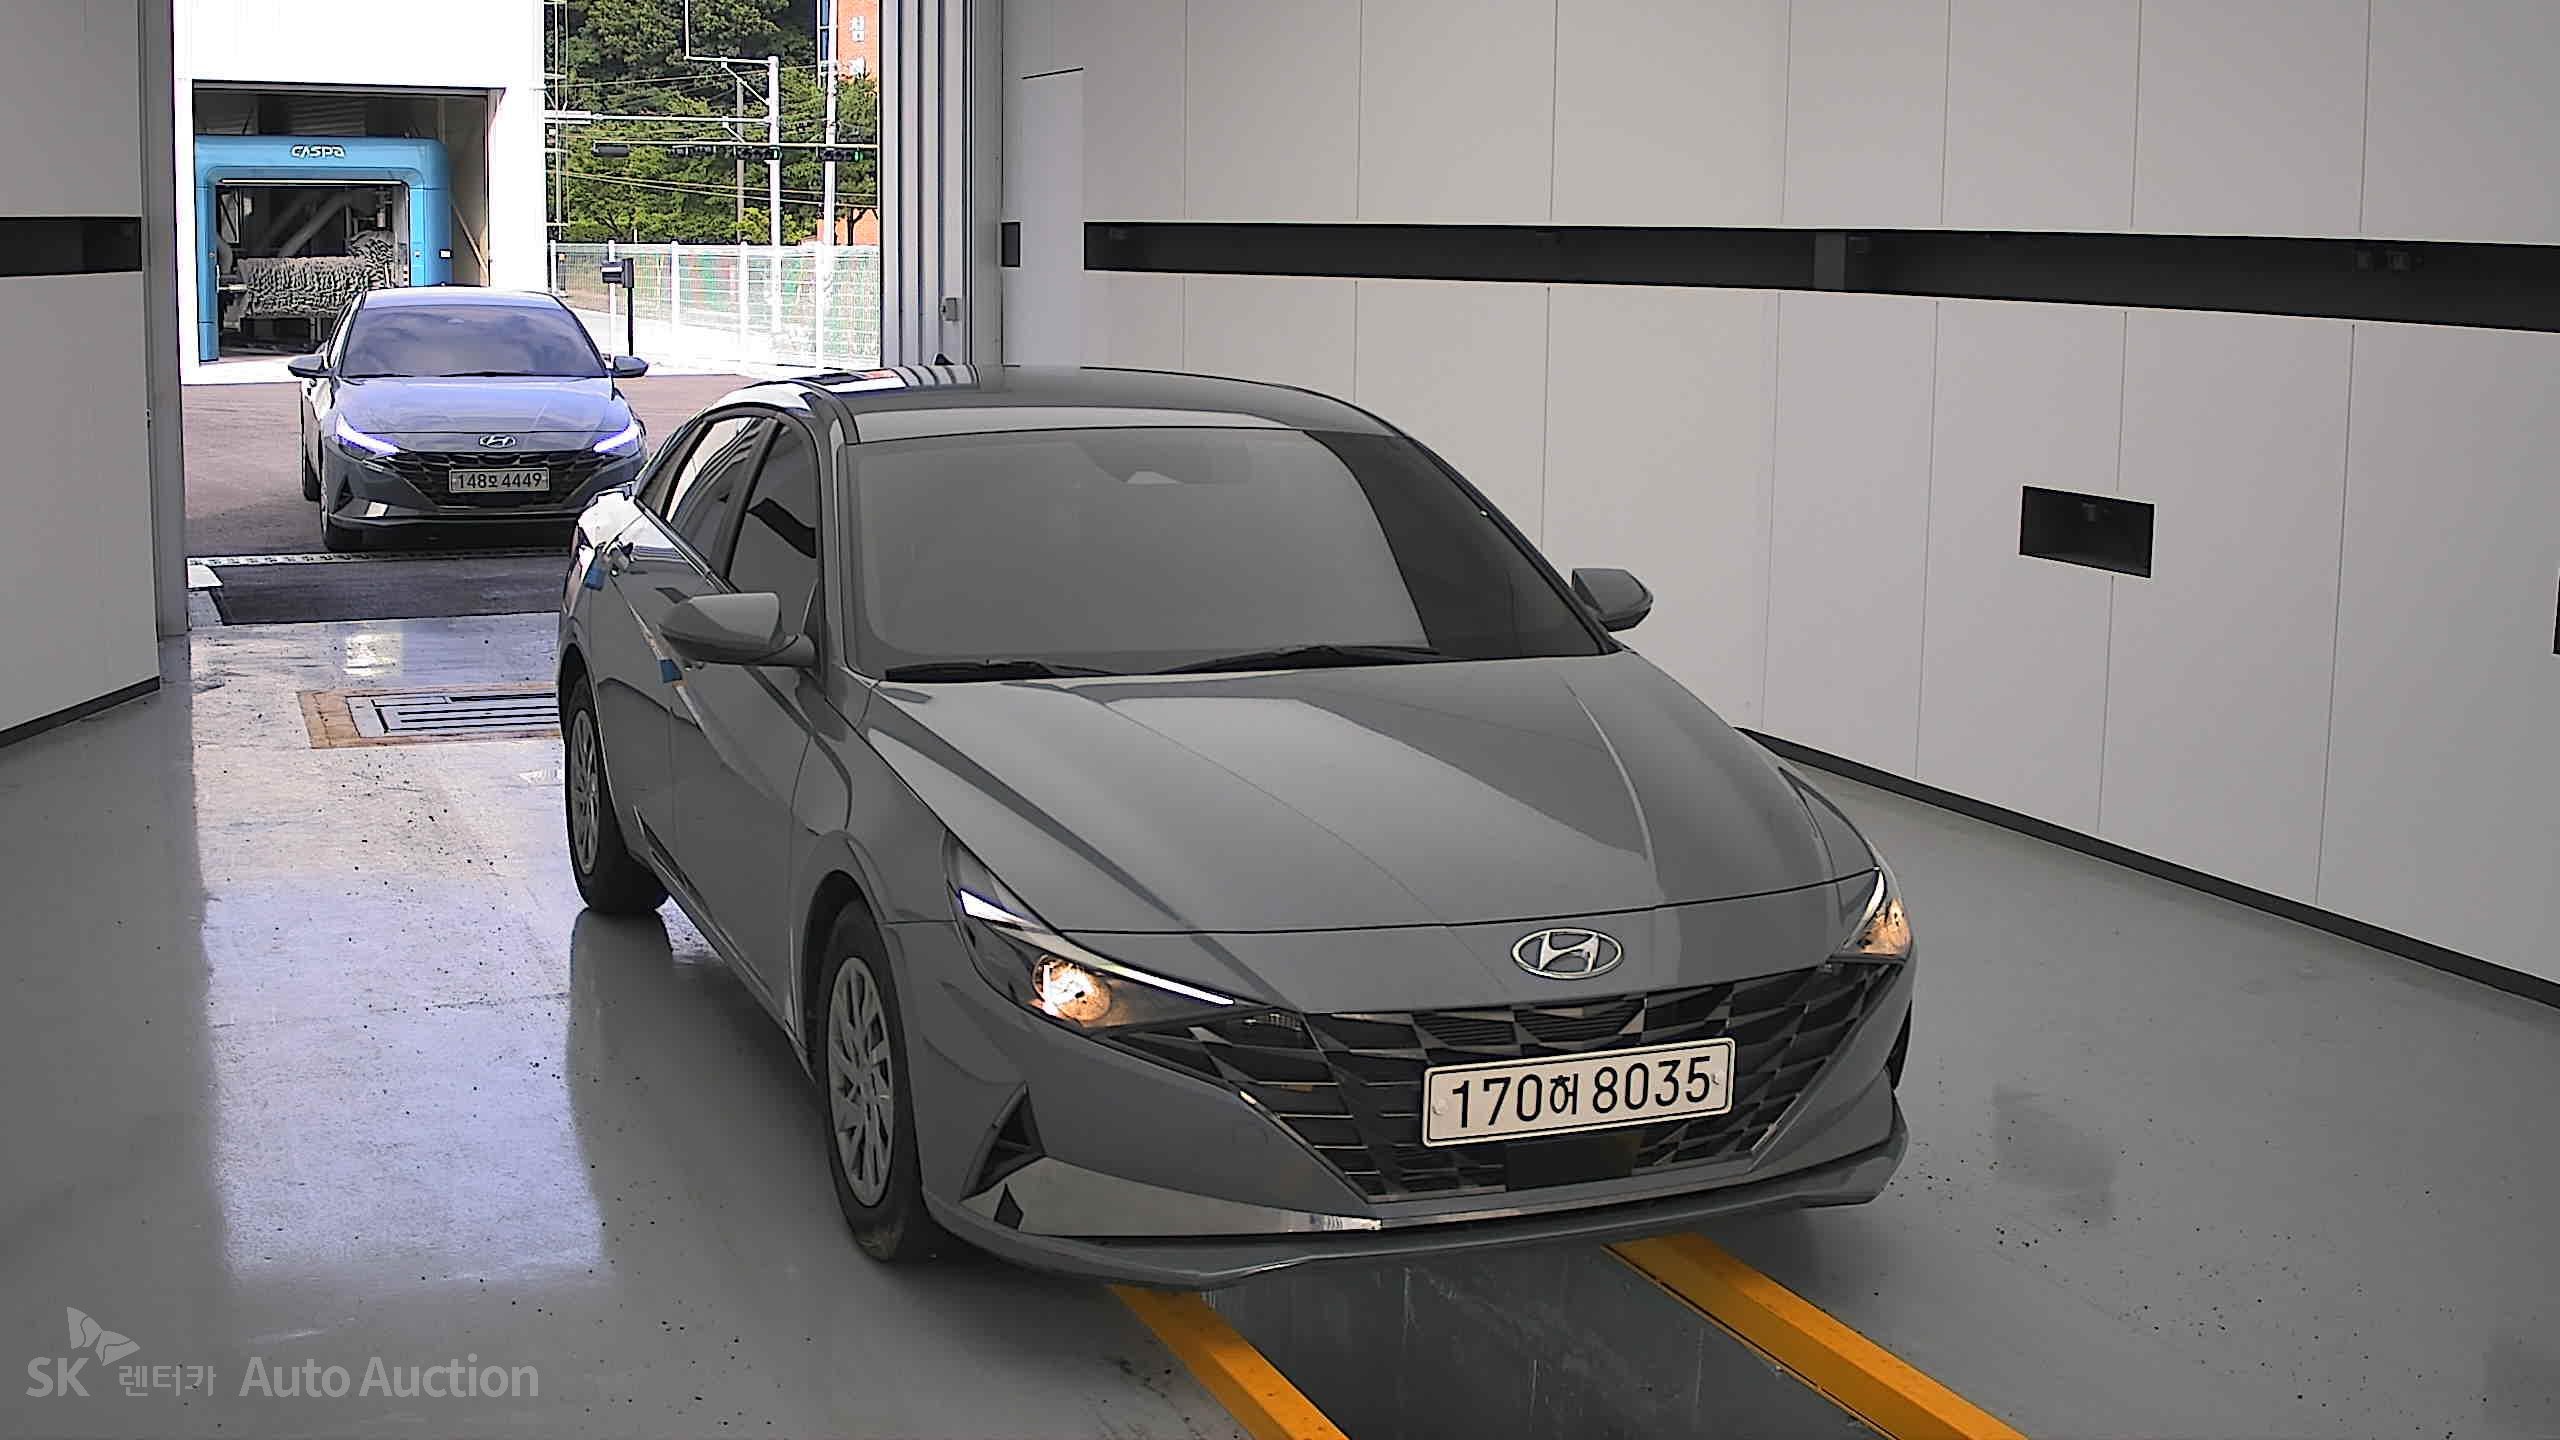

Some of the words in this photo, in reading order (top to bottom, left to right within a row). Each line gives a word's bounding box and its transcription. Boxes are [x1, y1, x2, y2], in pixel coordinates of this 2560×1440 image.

[501, 472, 542, 488] 4449
[1452, 1073, 1579, 1129] 170허
[1592, 1055, 1711, 1114] 8035
